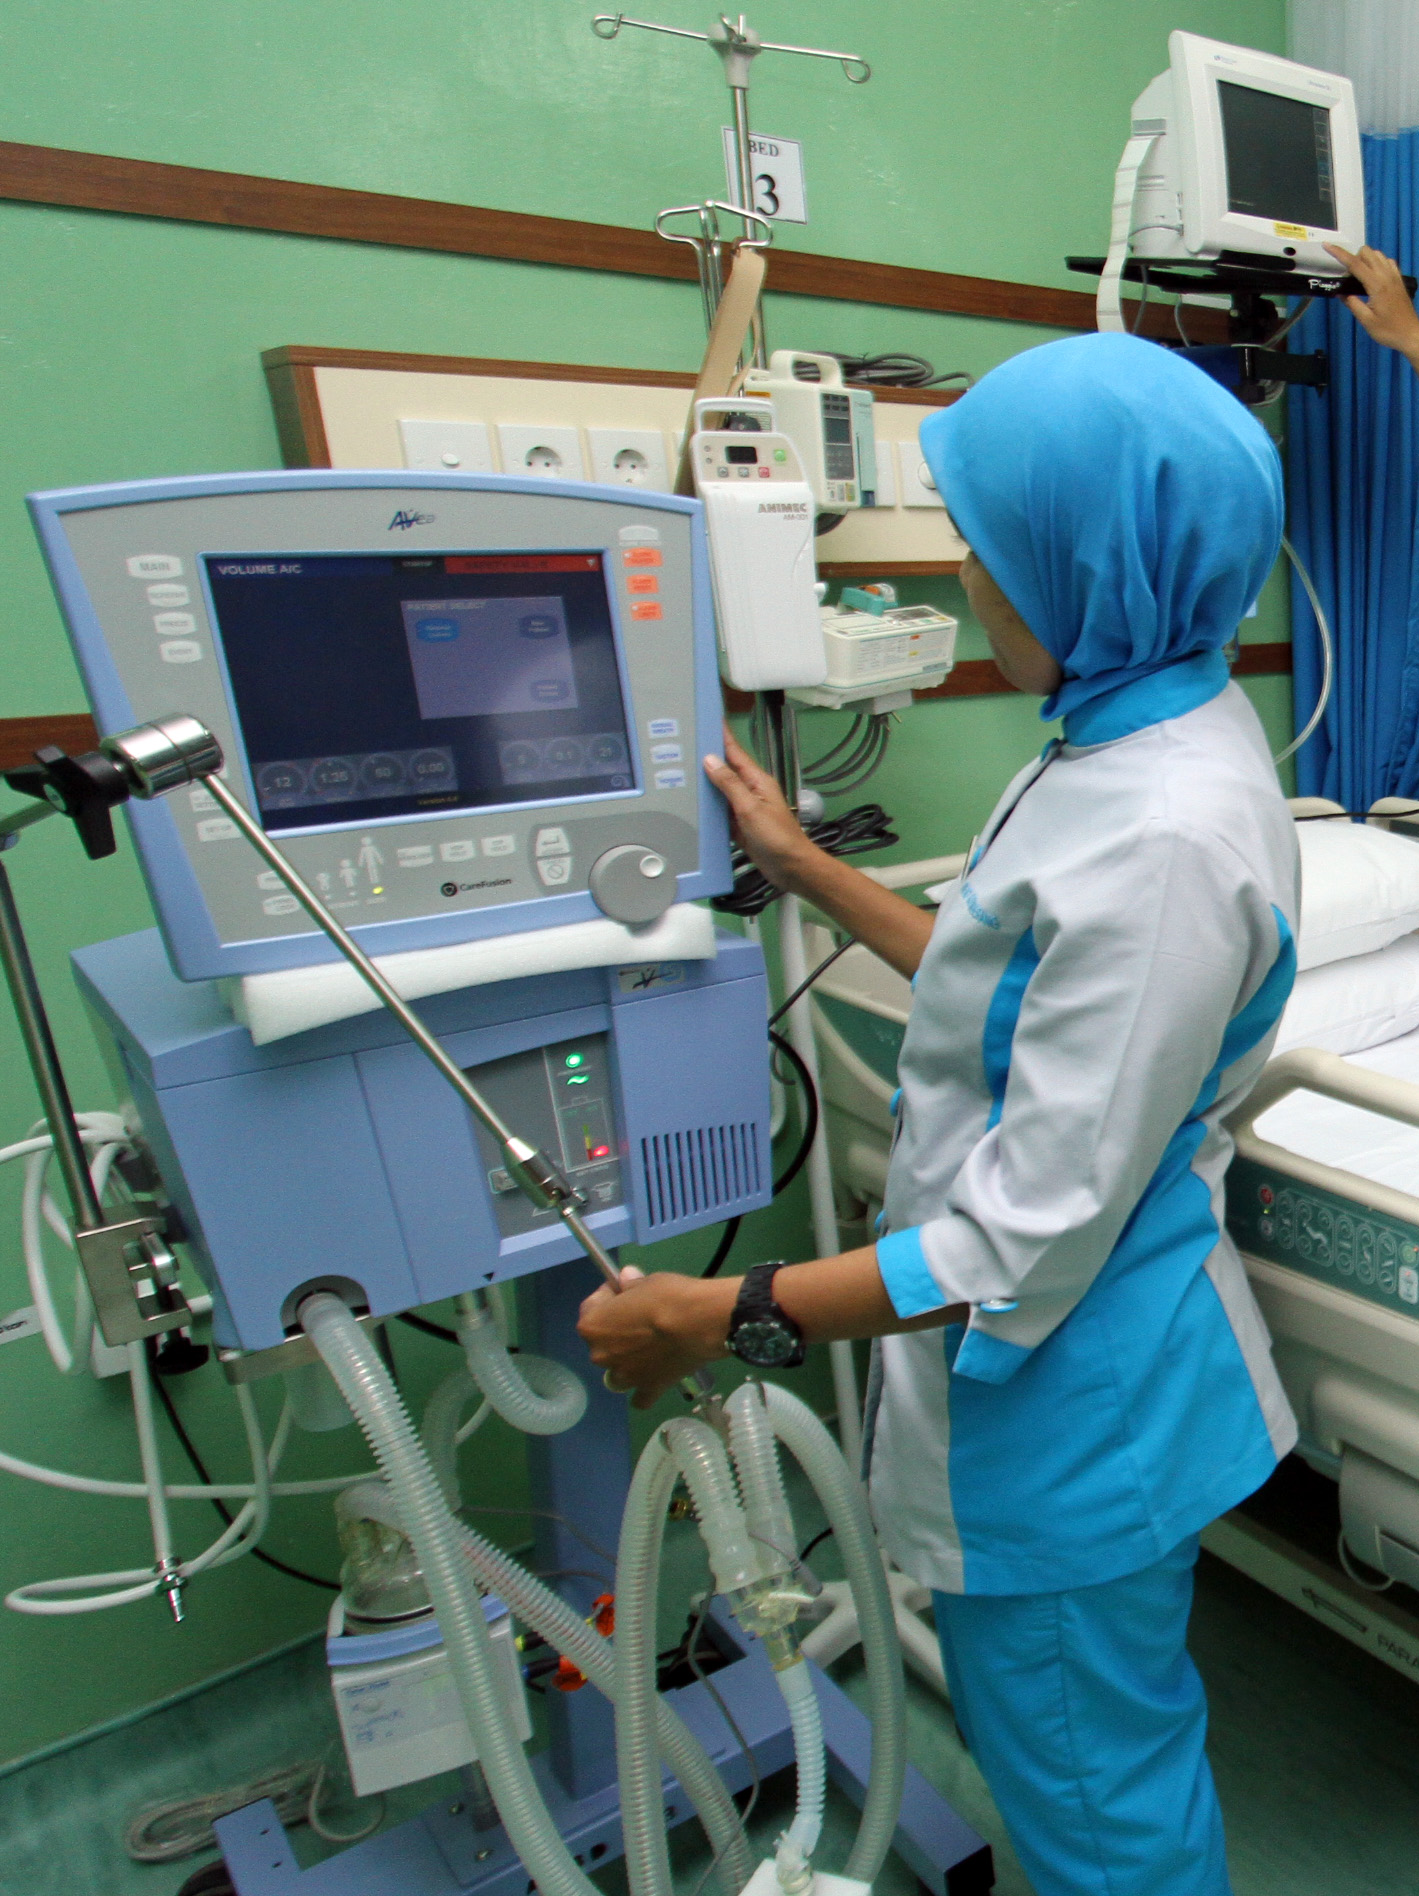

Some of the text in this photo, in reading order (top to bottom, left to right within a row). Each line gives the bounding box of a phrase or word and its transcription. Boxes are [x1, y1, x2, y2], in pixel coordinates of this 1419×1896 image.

[750, 140, 780, 157] BED
[755, 173, 780, 217] 3
[216, 564, 276, 576] VOLUME
[459, 878, 514, 892] CareFusion
